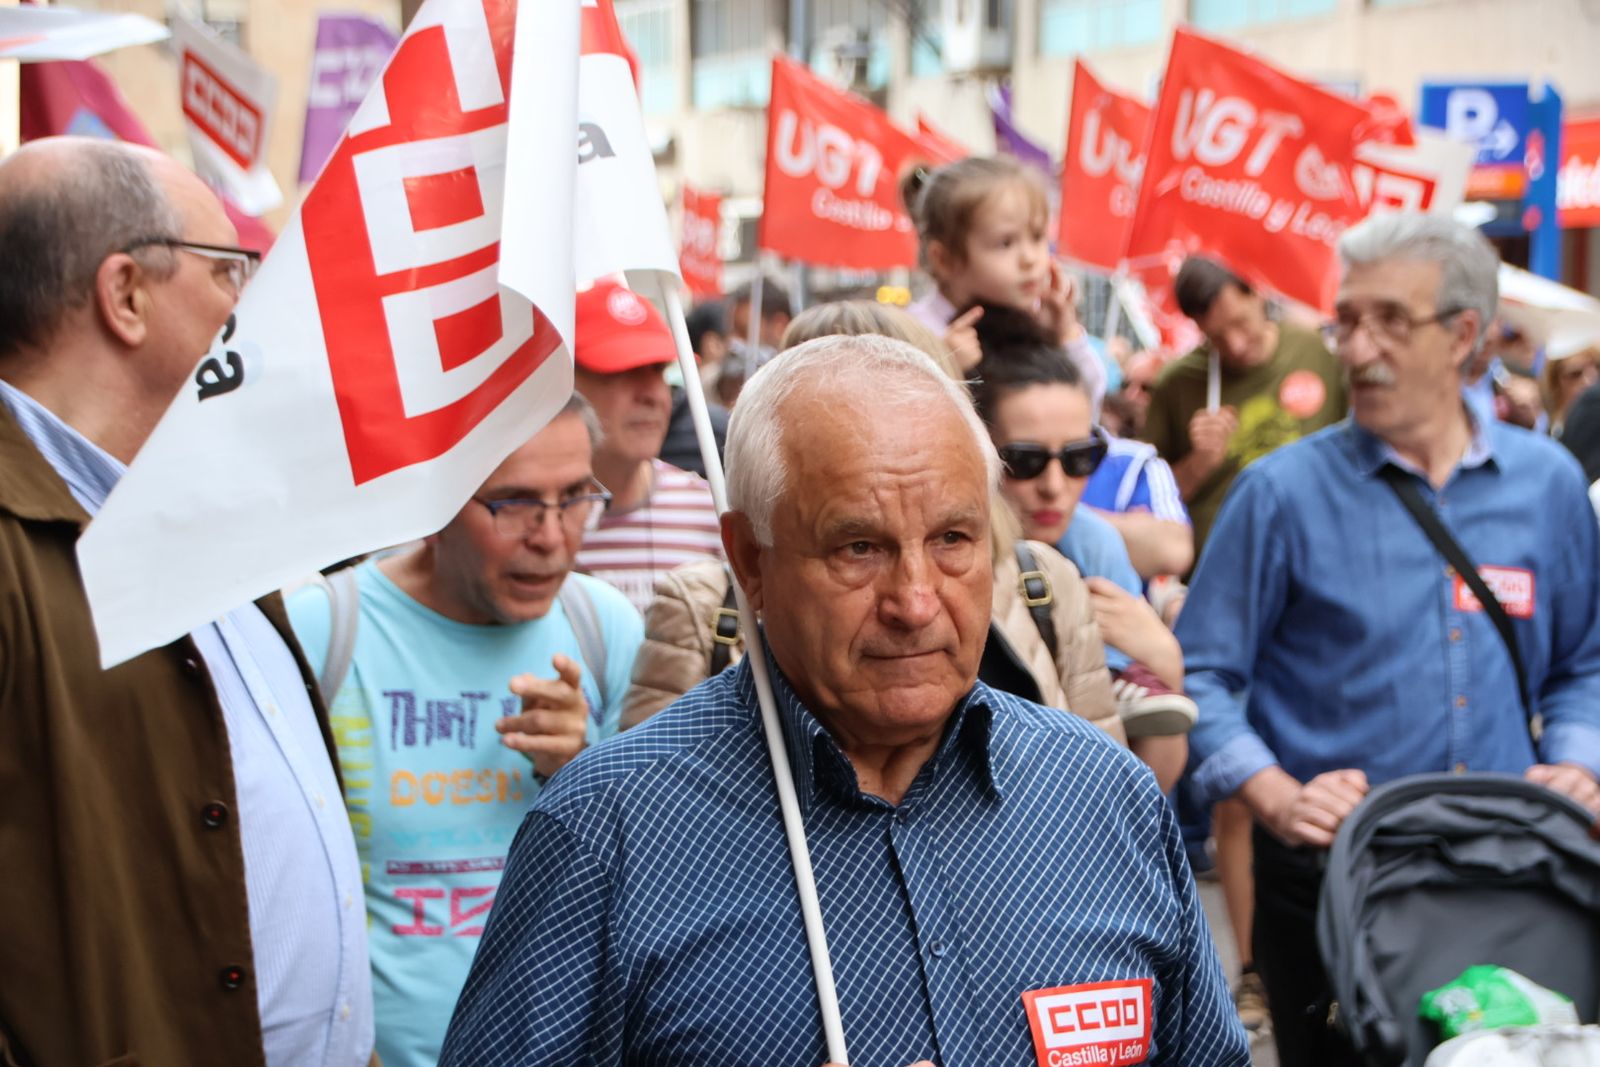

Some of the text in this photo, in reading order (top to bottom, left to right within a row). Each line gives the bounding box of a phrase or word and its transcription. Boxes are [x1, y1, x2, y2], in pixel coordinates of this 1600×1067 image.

[1171, 87, 1304, 177] UGT
[1445, 87, 1498, 142] P
[773, 108, 884, 197] UGT
[382, 690, 490, 751] THAT
[1048, 998, 1138, 1034] CCOO
[1047, 1040, 1143, 1067] Castilla y León
